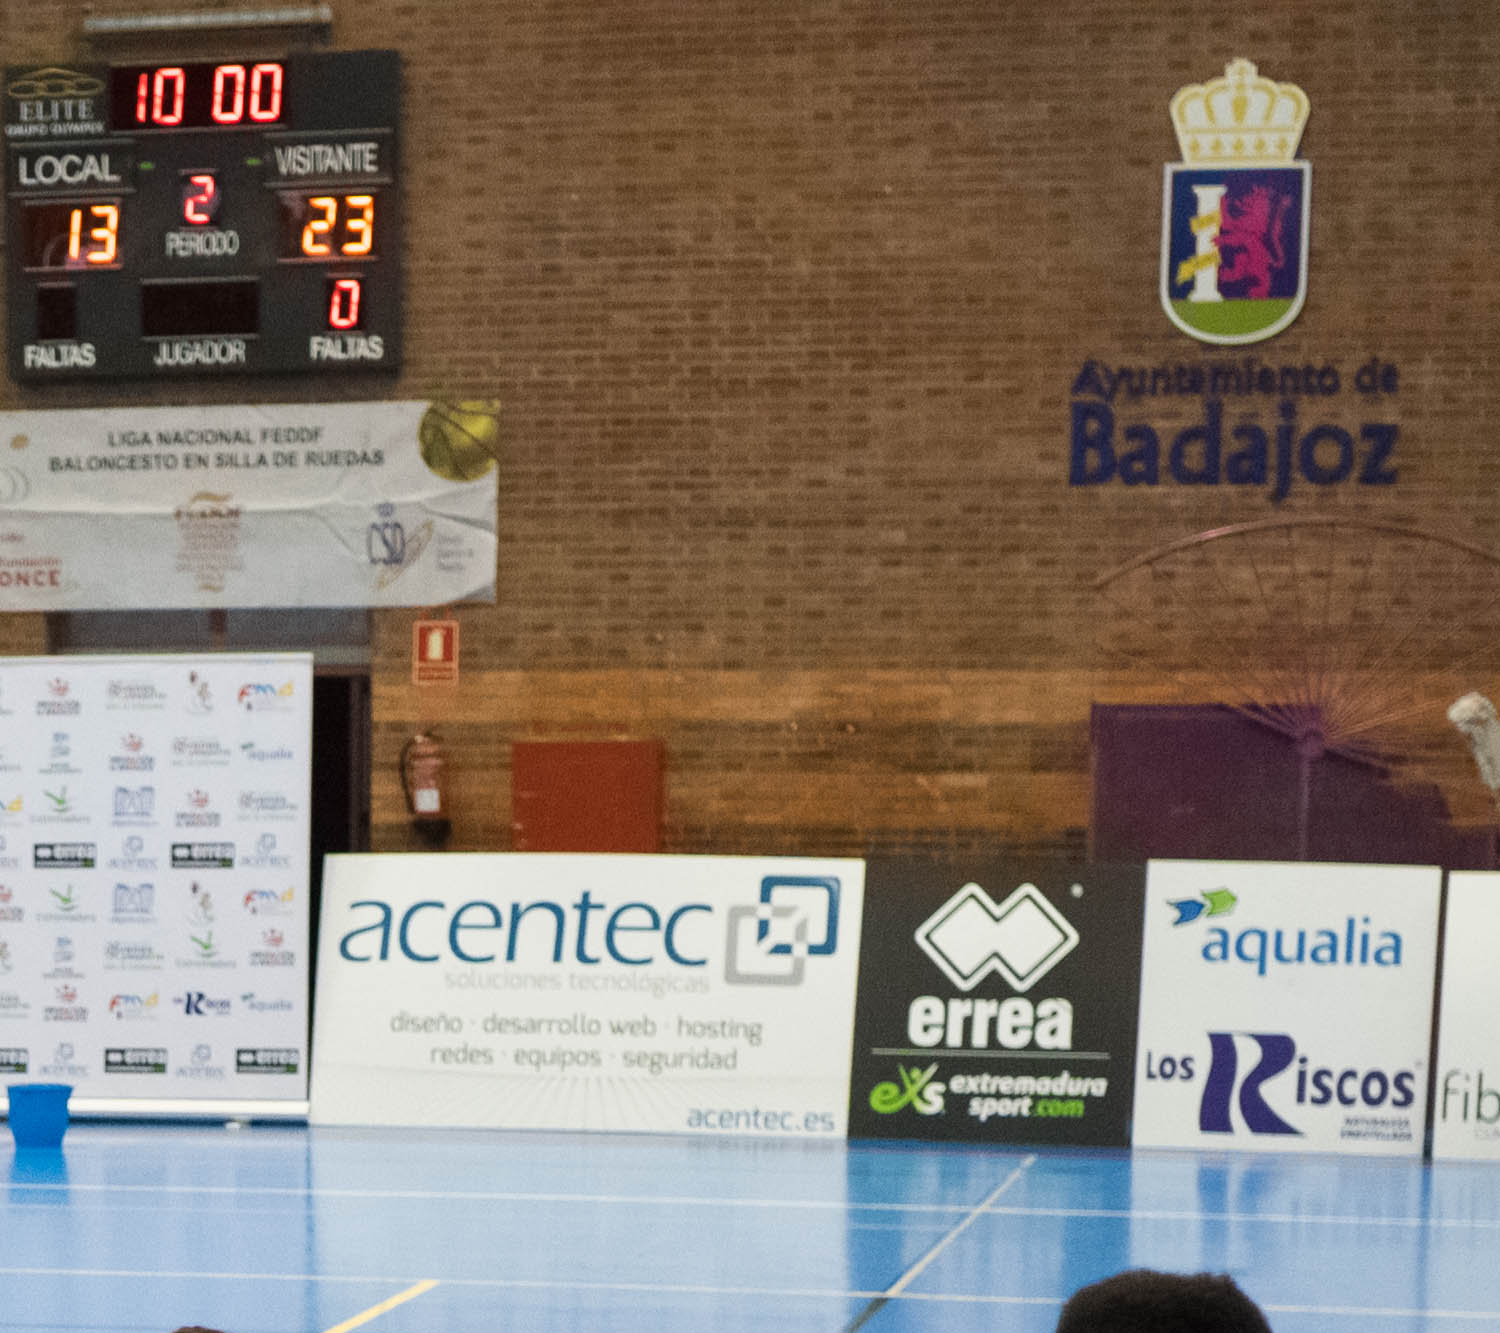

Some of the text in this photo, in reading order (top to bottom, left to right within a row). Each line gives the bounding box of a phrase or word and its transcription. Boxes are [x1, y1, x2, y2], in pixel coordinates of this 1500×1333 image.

[136, 63, 283, 125] 10 00
[19, 100, 95, 122] ELITE
[18, 154, 122, 185] LOCAL
[275, 142, 379, 175] VISITANTE
[184, 174, 215, 224] 2
[68, 204, 120, 264] 13
[302, 195, 375, 256] 23
[165, 231, 239, 257] PERIODO
[328, 279, 361, 329] 0
[24, 343, 96, 369] FALTAS
[153, 340, 247, 367] JUGADOR
[310, 335, 384, 361] FALTAS
[1072, 356, 1399, 402] Ayuntamiento de
[107, 429, 152, 448] LIGA
[156, 427, 253, 446] NACIONAL
[1069, 399, 1400, 508] Badajoz
[50, 448, 385, 473] BALONCESTO EN SILLA DE RUEDAS
[338, 889, 715, 969] acentec
[1200, 917, 1404, 977] aqualia
[443, 968, 711, 999] soluciones tecnológicas
[390, 1009, 764, 1047] diseño desarrollo web hosting
[907, 994, 1075, 1051] errea
[429, 1042, 739, 1077] redes equipos seguridad
[949, 1070, 1109, 1097] extremadura
[685, 1104, 837, 1134] acentec.es
[968, 1096, 1085, 1123] sport.com
